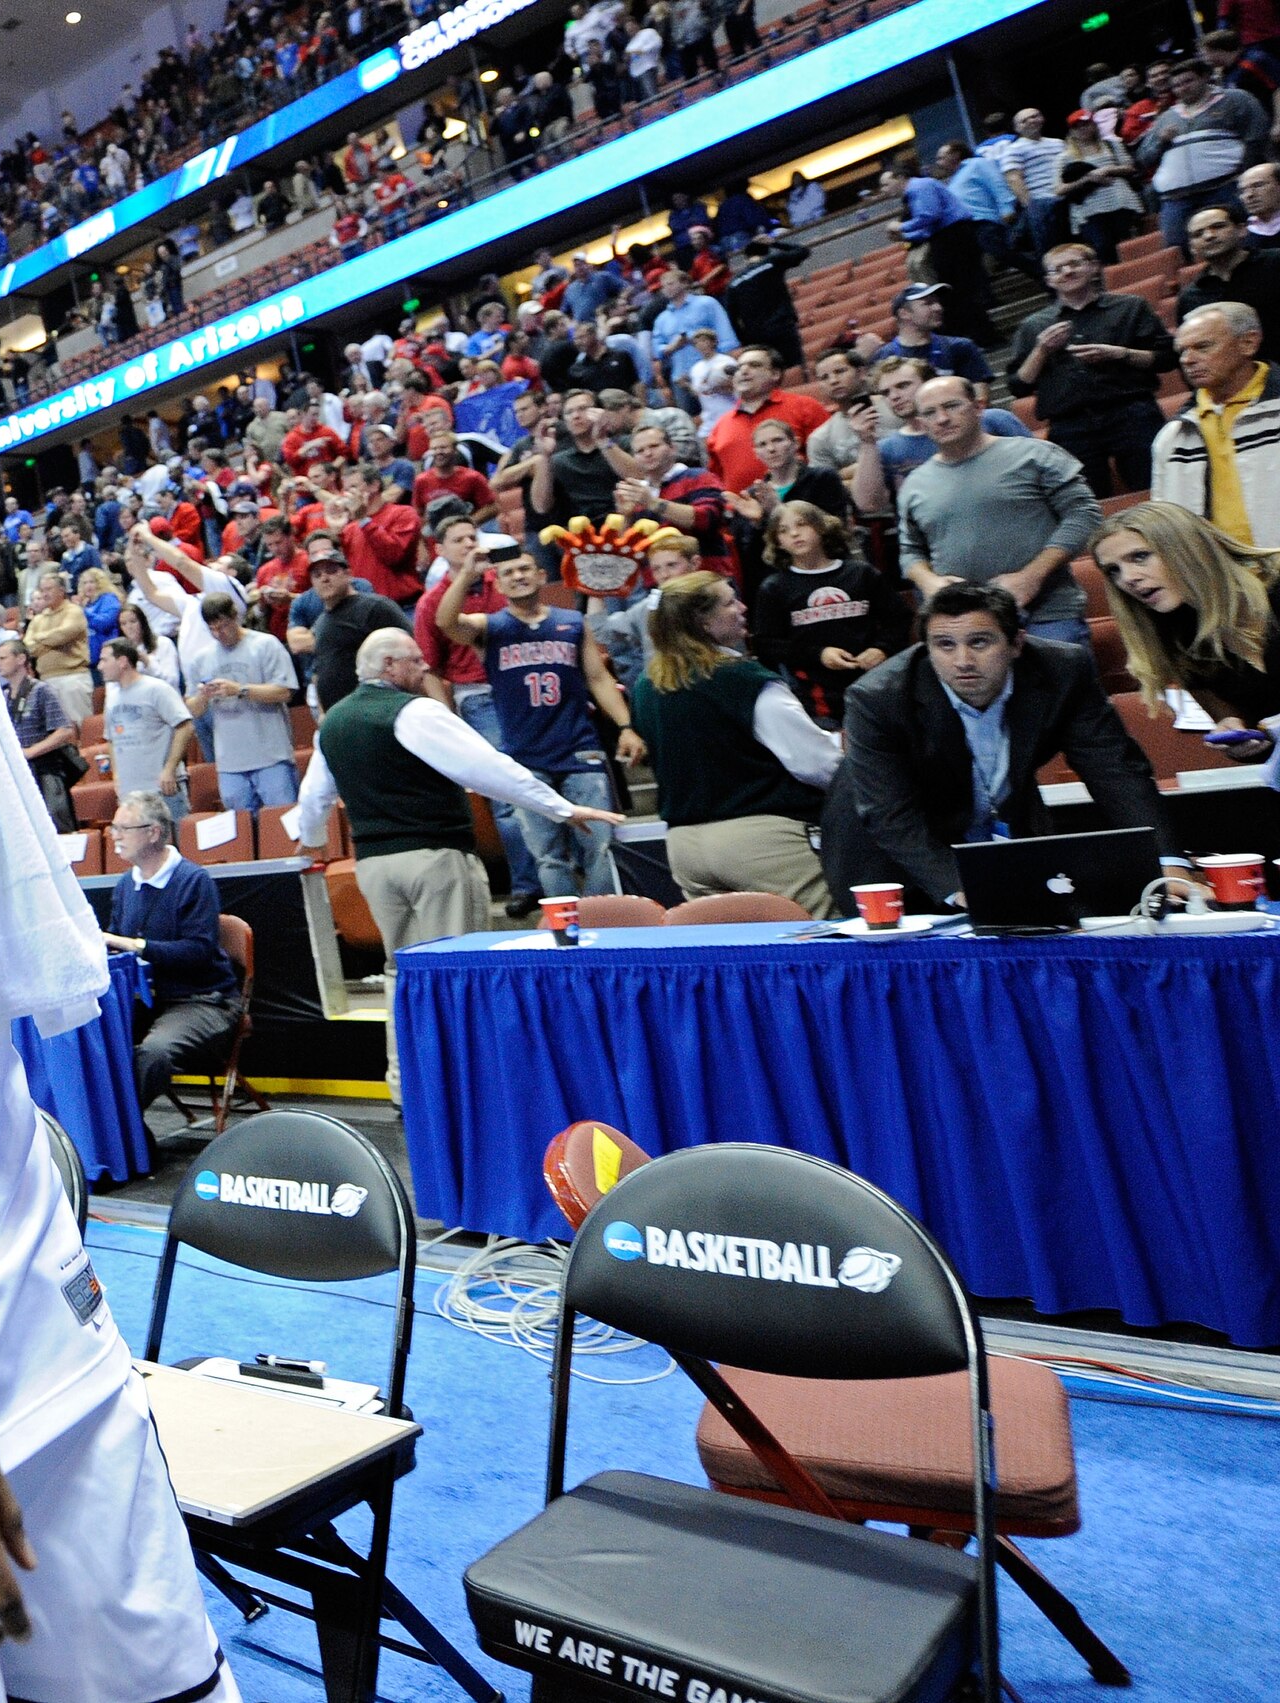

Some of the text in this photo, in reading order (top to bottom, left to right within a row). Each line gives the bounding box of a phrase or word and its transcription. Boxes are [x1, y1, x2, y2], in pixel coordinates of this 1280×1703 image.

[124, 352, 159, 390] of
[169, 295, 305, 373] Arizona
[524, 671, 561, 707] 13
[220, 1172, 333, 1215] BASKETBALL
[645, 1225, 840, 1288] BASKETBALL
[514, 1619, 553, 1654] WE
[558, 1636, 615, 1676] ARE
[621, 1655, 680, 1698] THE
